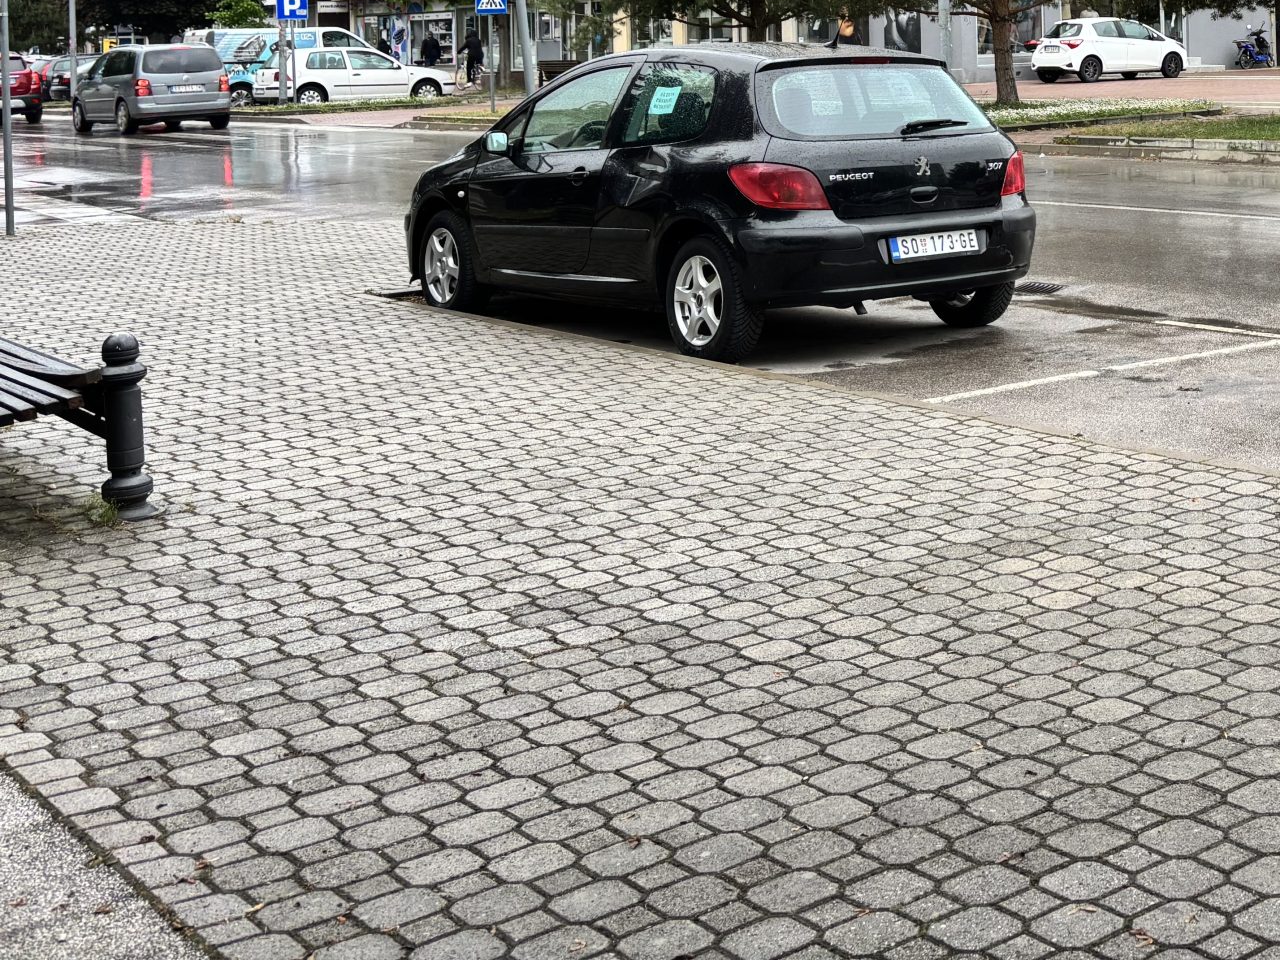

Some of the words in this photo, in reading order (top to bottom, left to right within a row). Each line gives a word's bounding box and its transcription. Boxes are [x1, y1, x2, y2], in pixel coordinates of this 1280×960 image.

[987, 161, 1003, 171] 307
[829, 172, 875, 182] PEUGEOT
[901, 237, 919, 255] SO
